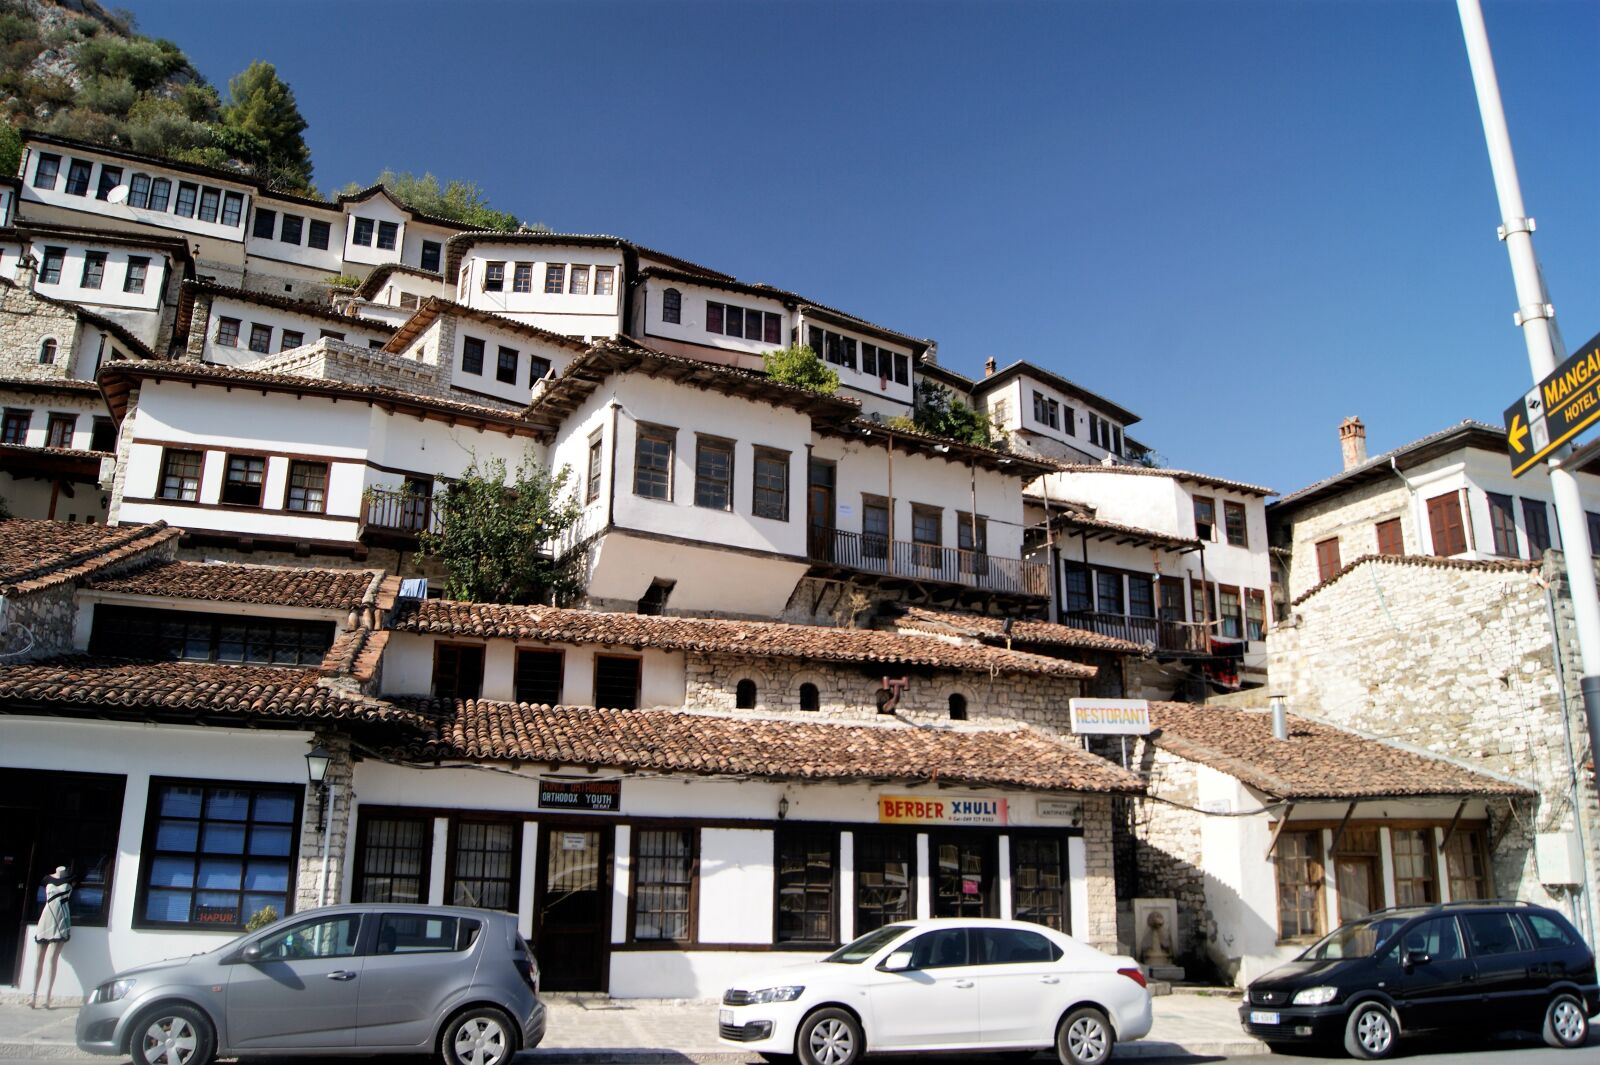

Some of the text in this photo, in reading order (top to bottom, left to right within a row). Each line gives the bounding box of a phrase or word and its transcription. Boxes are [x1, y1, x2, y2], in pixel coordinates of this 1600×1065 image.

[1564, 391, 1597, 423] HOTEL
[1075, 707, 1146, 724] RESTORANT
[542, 792, 612, 804] ORTHODOX YOUTH
[884, 801, 997, 819] BERBER XHULI
[199, 912, 233, 922] HAPUR
